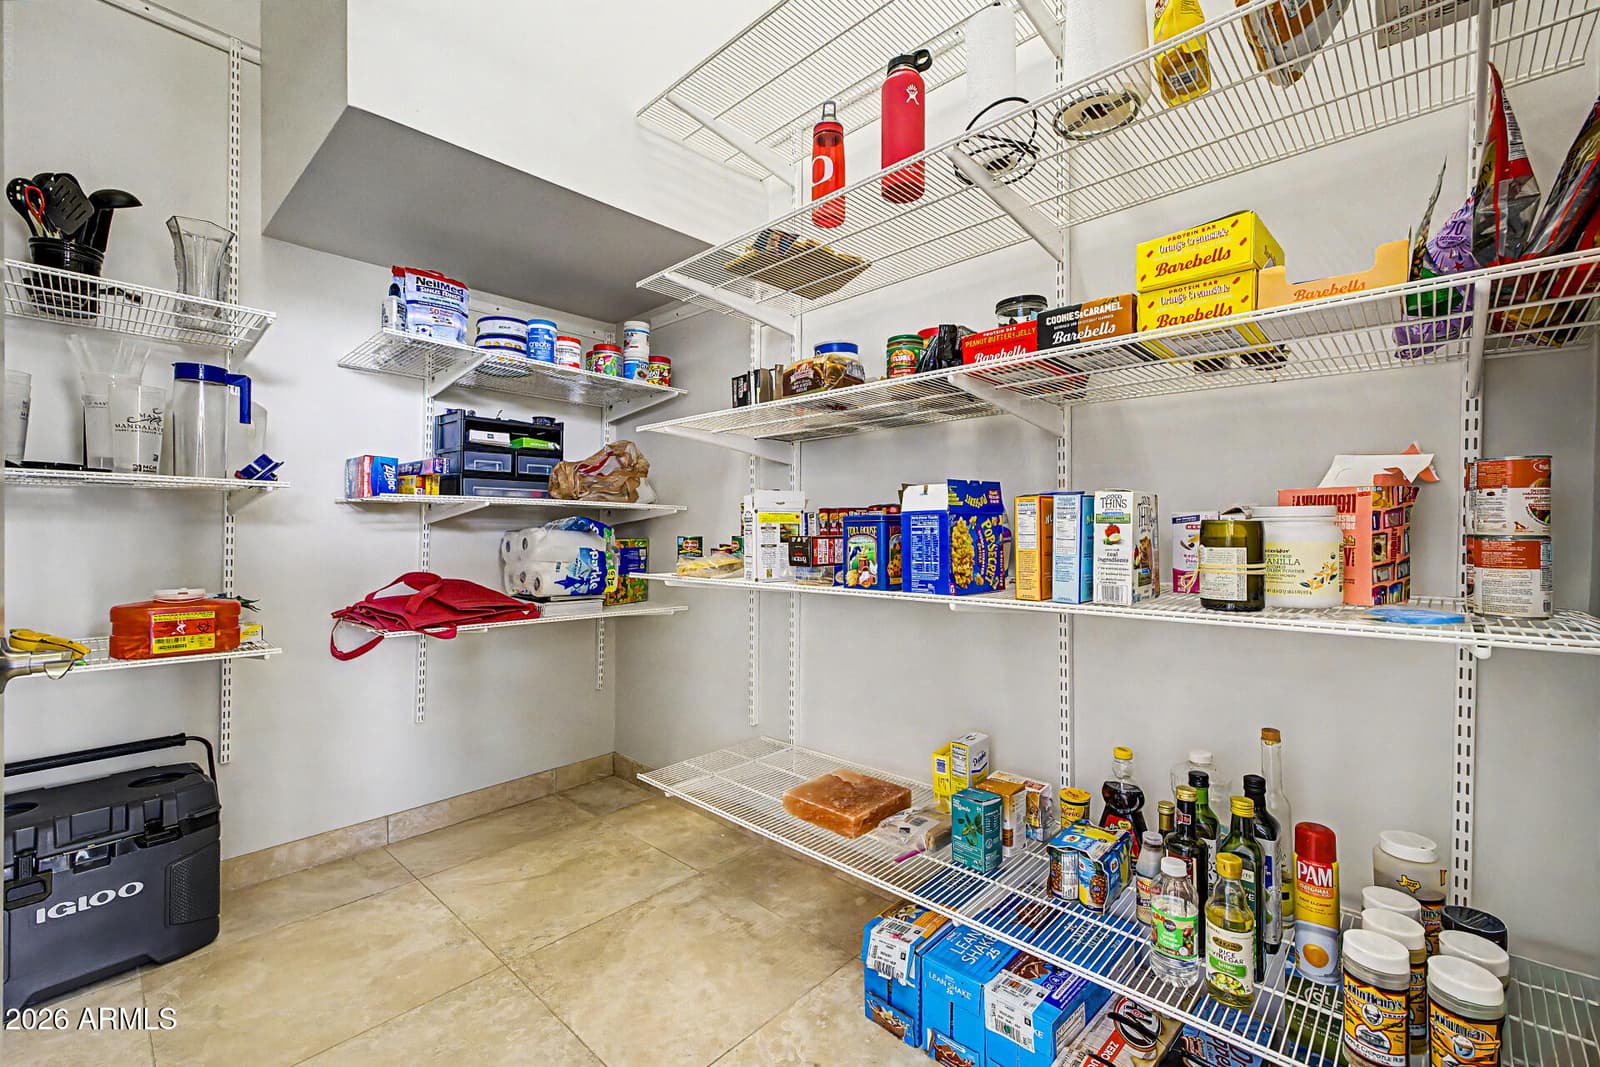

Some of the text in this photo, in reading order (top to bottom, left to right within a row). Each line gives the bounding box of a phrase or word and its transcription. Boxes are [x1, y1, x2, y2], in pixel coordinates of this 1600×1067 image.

[1168, 225, 1216, 242] PROTEIN BAR
[1155, 246, 1231, 277] Barebells
[415, 276, 464, 295] NeilMed
[1168, 284, 1200, 294] PROTEIN
[1293, 278, 1367, 302] Barebells
[1156, 302, 1233, 329] Barebells
[1052, 321, 1116, 345] Barebells
[974, 345, 1026, 363] Barebells
[383, 463, 396, 491] Ziploc
[1100, 497, 1128, 509] THINS
[981, 518, 996, 543] POP
[985, 543, 999, 586] SECRET
[1297, 860, 1333, 888] PAM
[36, 881, 144, 924] IGLOO
[950, 929, 983, 955] LEAN
[986, 947, 1001, 960] 25
[928, 971, 947, 987] LEAN
[1100, 1041, 1119, 1062] ZERO
